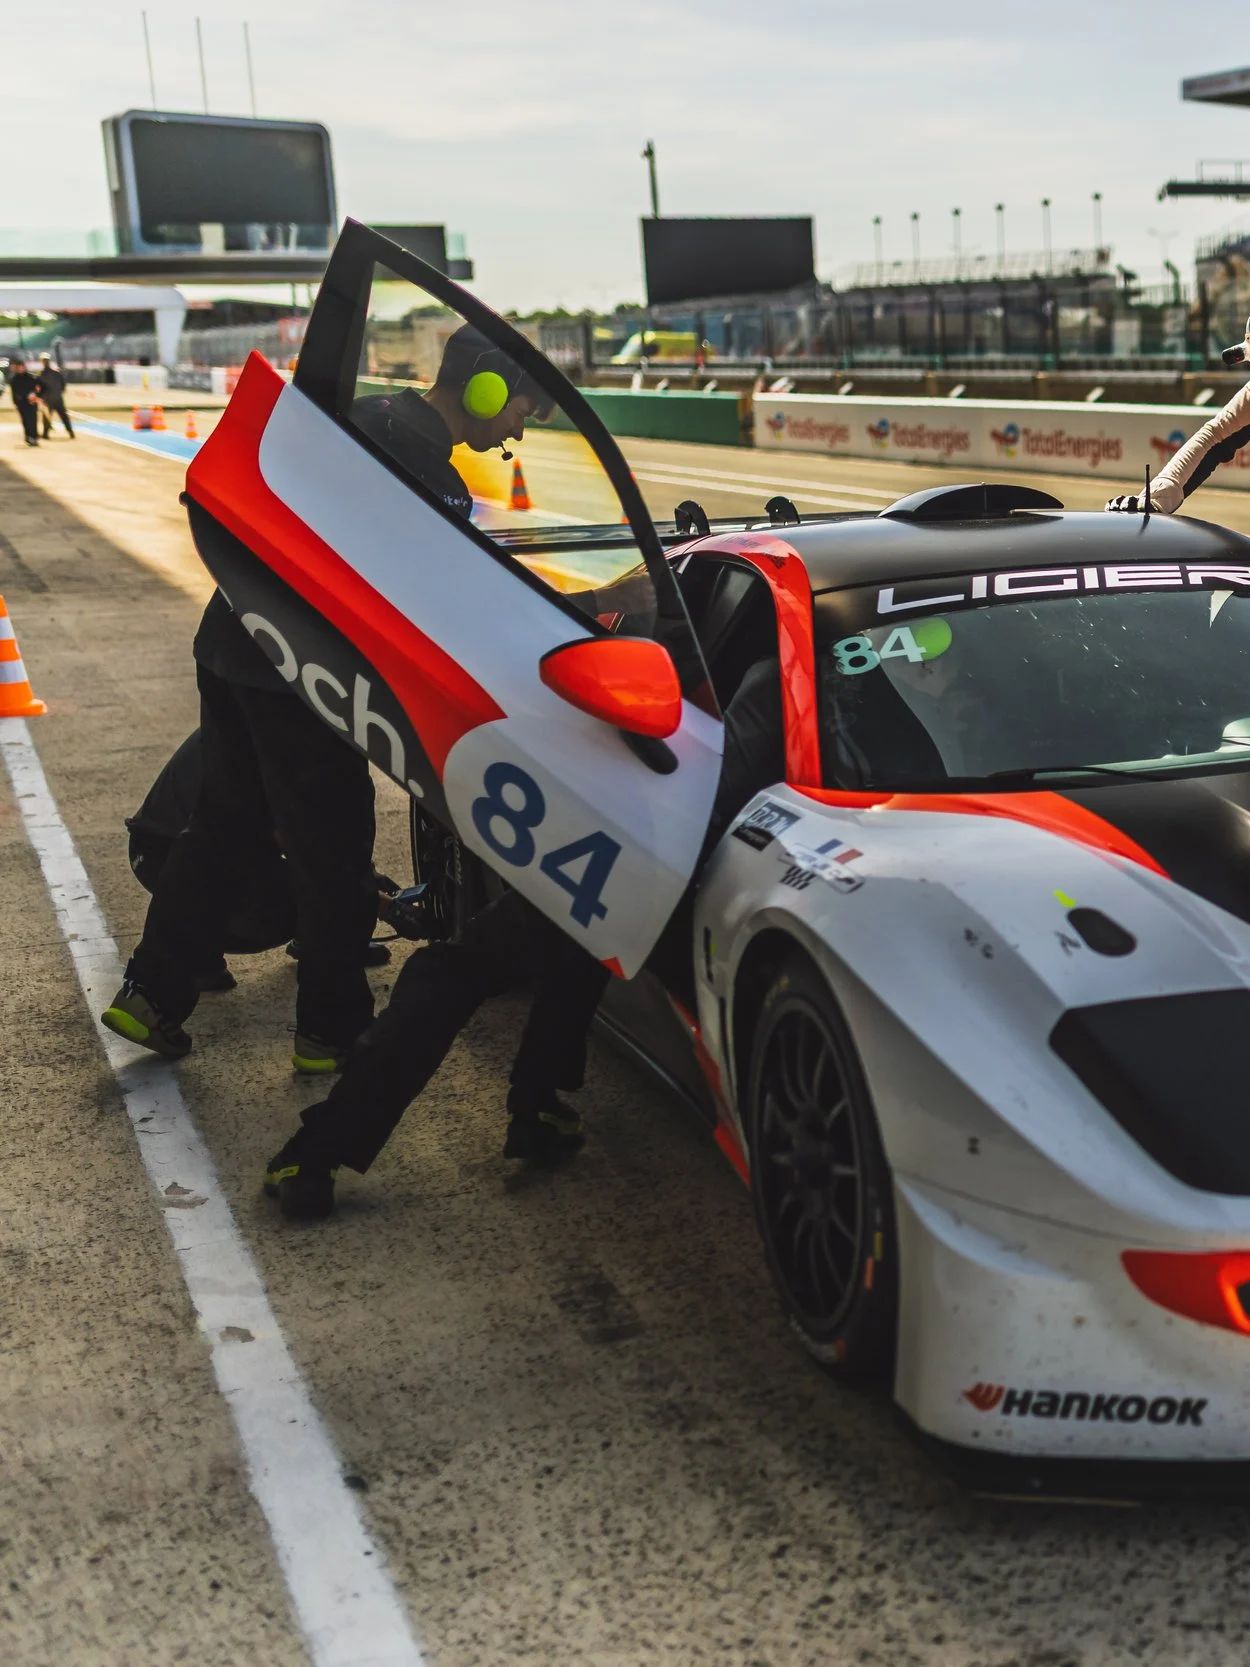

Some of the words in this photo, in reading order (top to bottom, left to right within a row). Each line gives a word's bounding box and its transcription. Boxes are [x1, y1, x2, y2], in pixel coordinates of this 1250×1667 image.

[891, 422, 971, 458] TotalEnergies
[1022, 427, 1124, 468] TotalEnergies
[833, 626, 926, 675] 84
[219, 586, 424, 798] och.
[472, 762, 622, 928] 84
